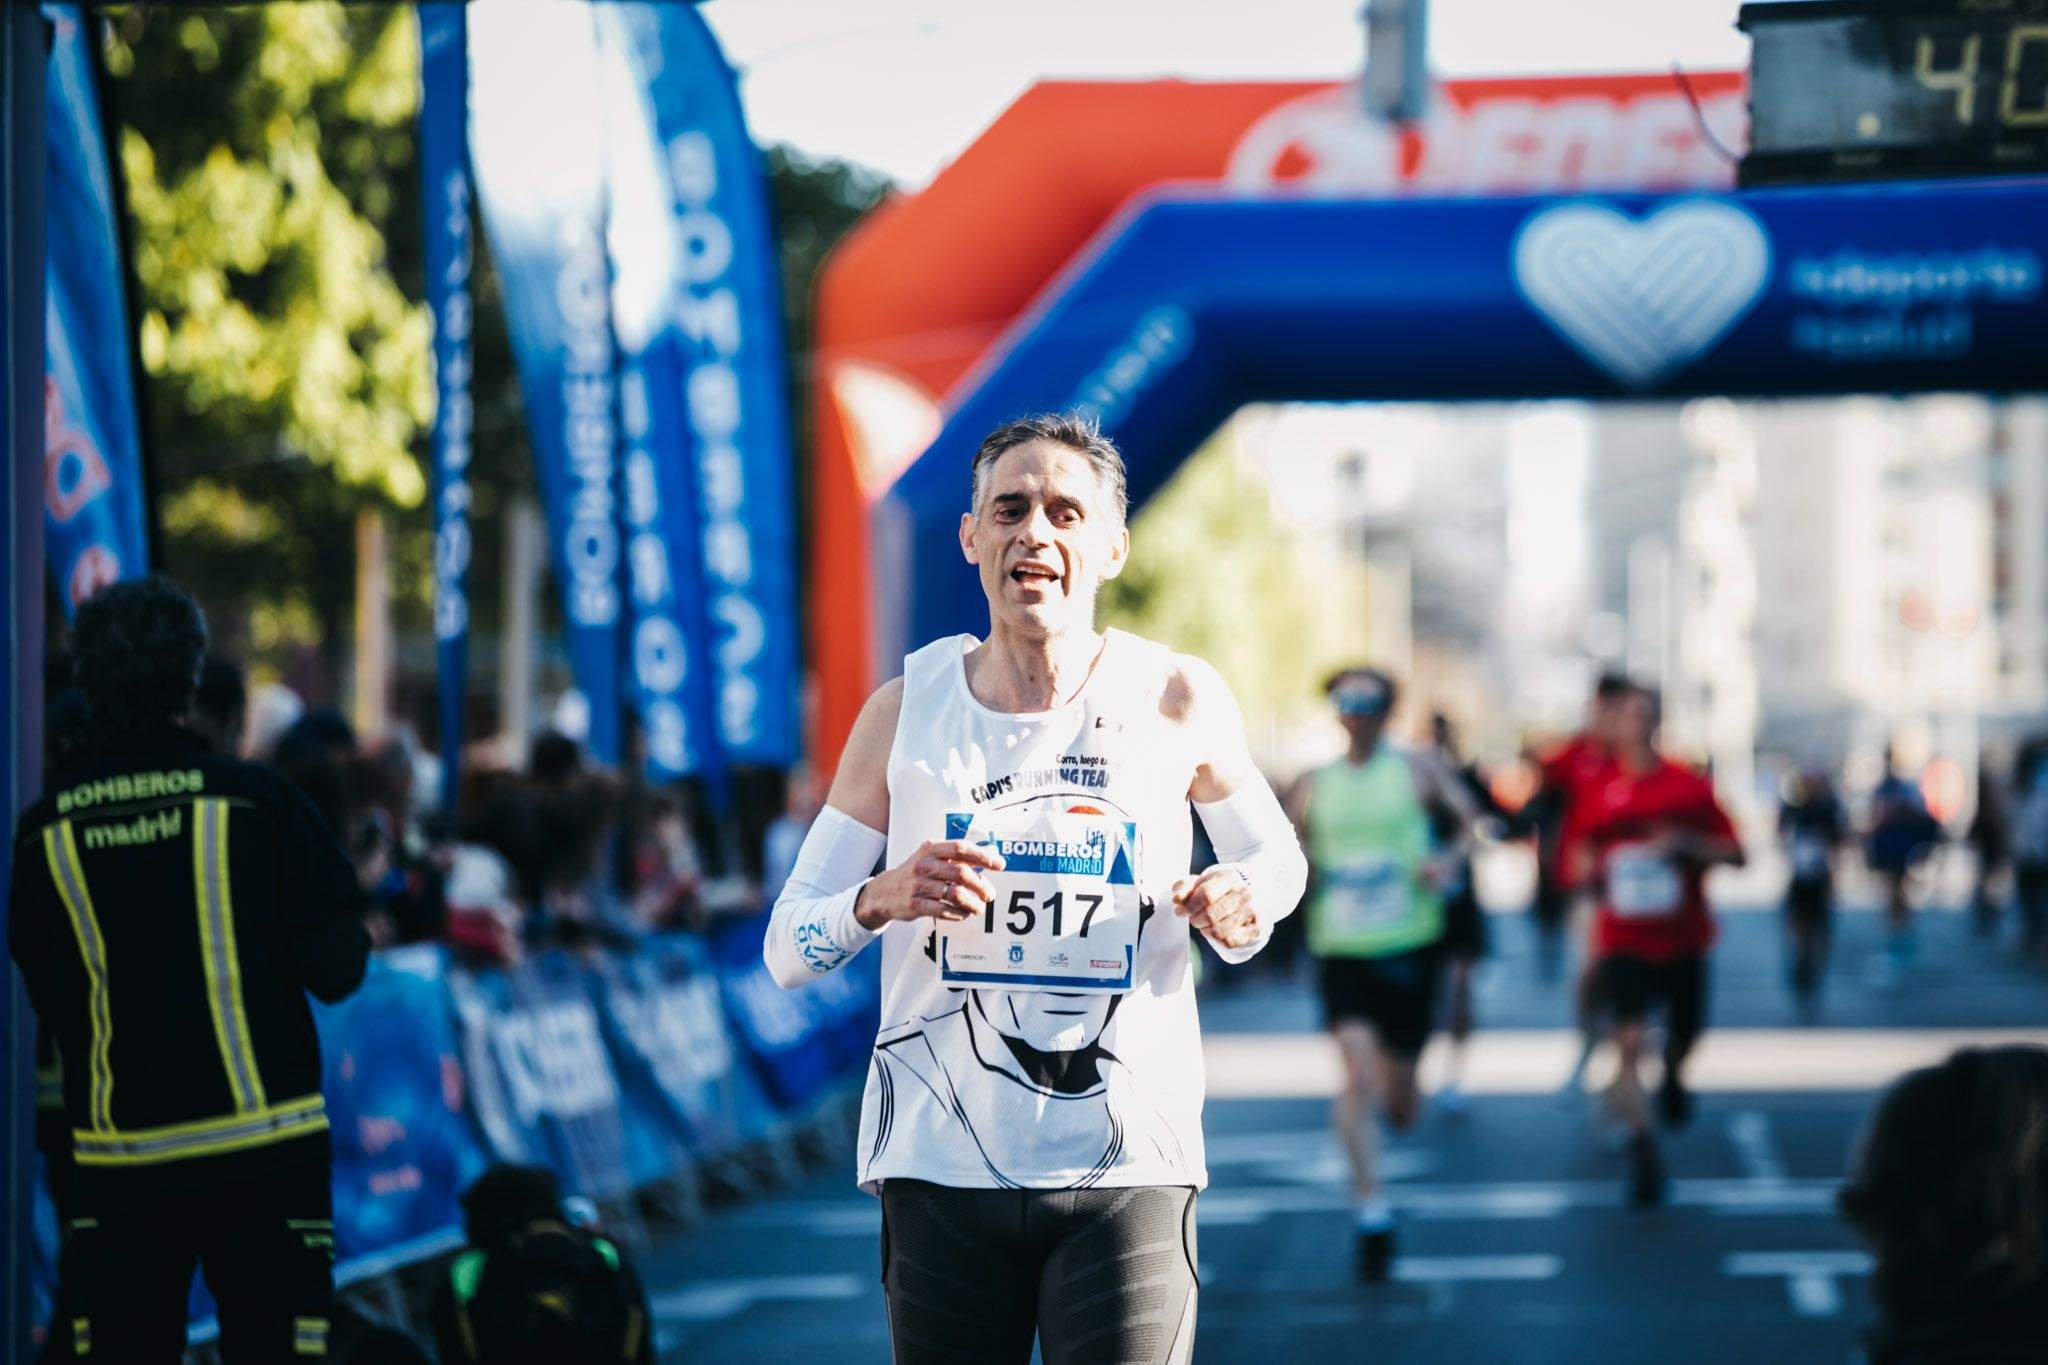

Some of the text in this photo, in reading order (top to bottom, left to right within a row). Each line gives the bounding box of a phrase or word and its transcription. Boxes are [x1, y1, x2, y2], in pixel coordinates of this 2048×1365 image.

[57, 769, 204, 813] BOMBEROS
[971, 775, 1014, 804] CAPI'S
[85, 807, 182, 848] madrid
[1002, 841, 1102, 859] BOMBEROS
[1041, 857, 1054, 871] de
[985, 891, 1103, 938] 1517
